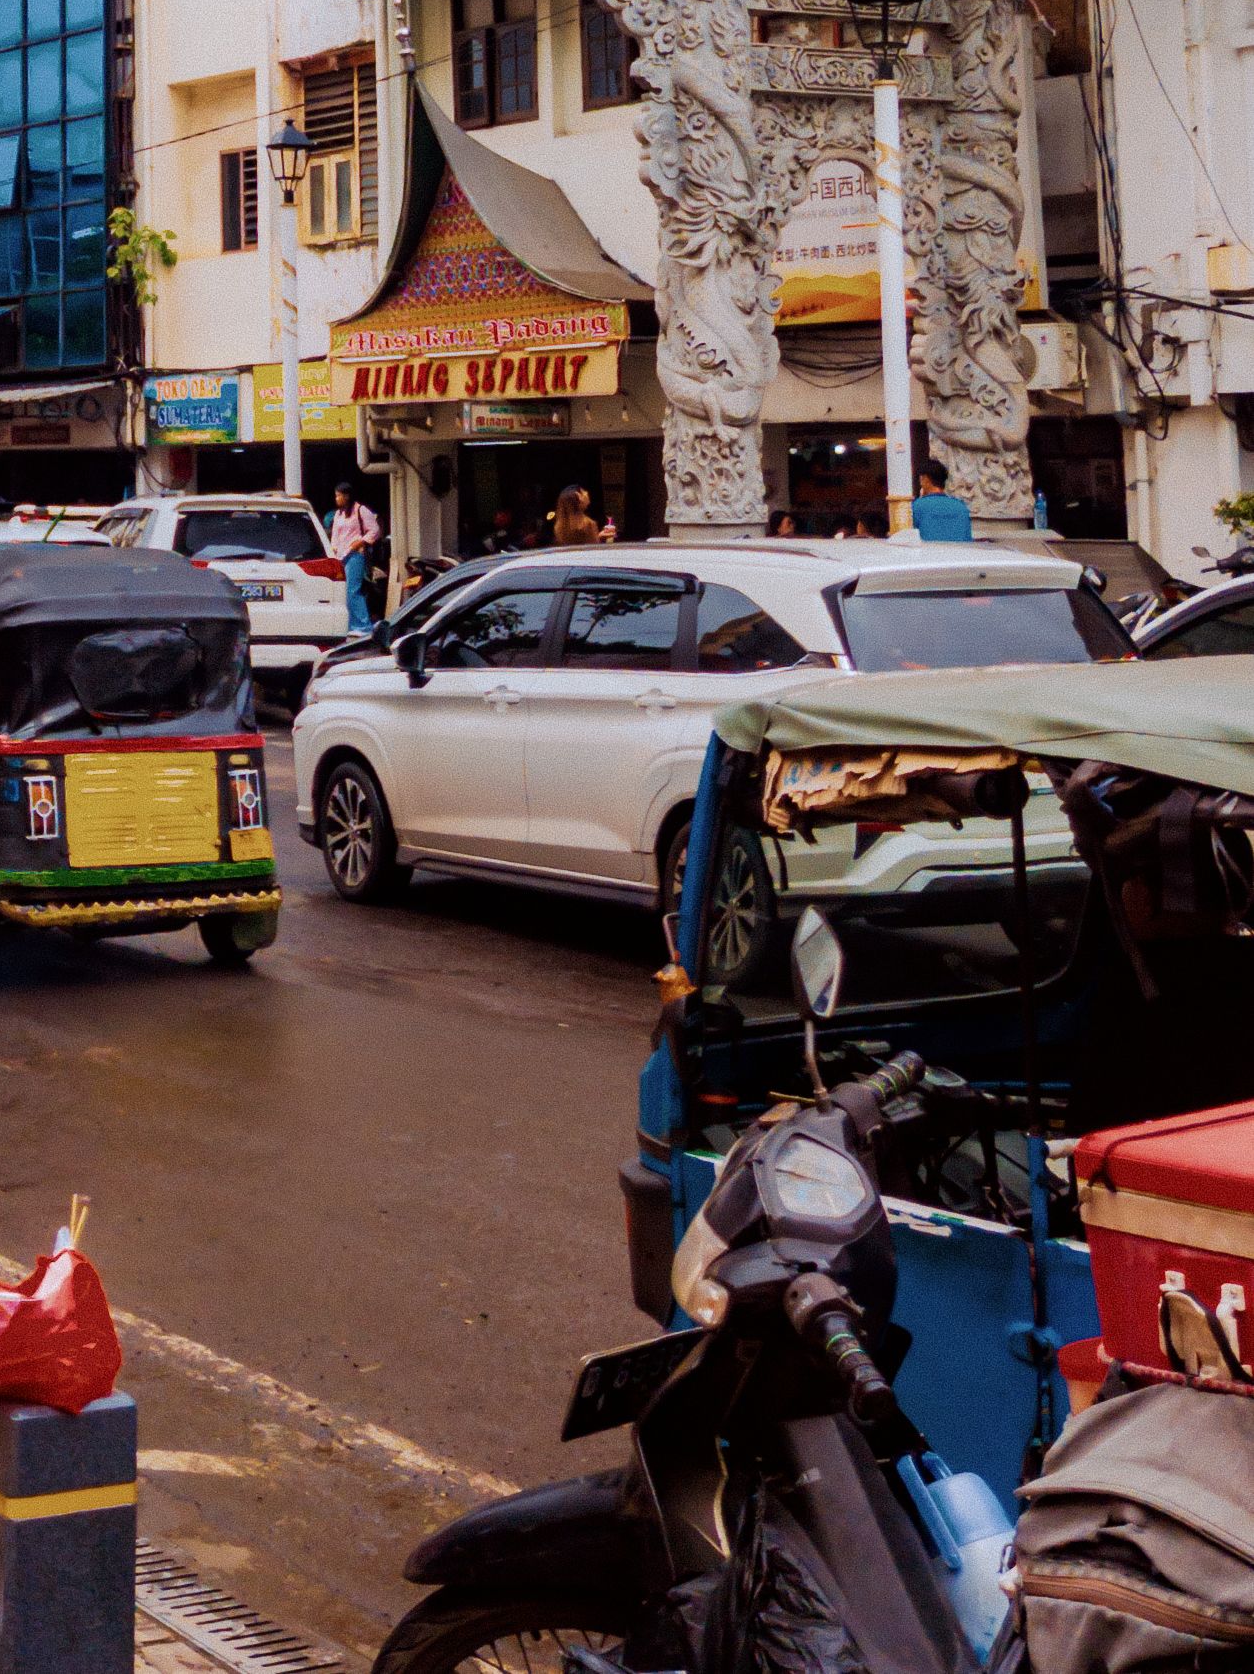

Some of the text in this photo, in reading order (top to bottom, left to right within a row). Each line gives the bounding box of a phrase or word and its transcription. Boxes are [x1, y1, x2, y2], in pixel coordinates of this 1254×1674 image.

[346, 314, 610, 353] Masakan Padang
[154, 378, 188, 402] TOKO
[351, 355, 588, 402] MINANG SEPAKAT
[157, 404, 224, 427] SUMATERA
